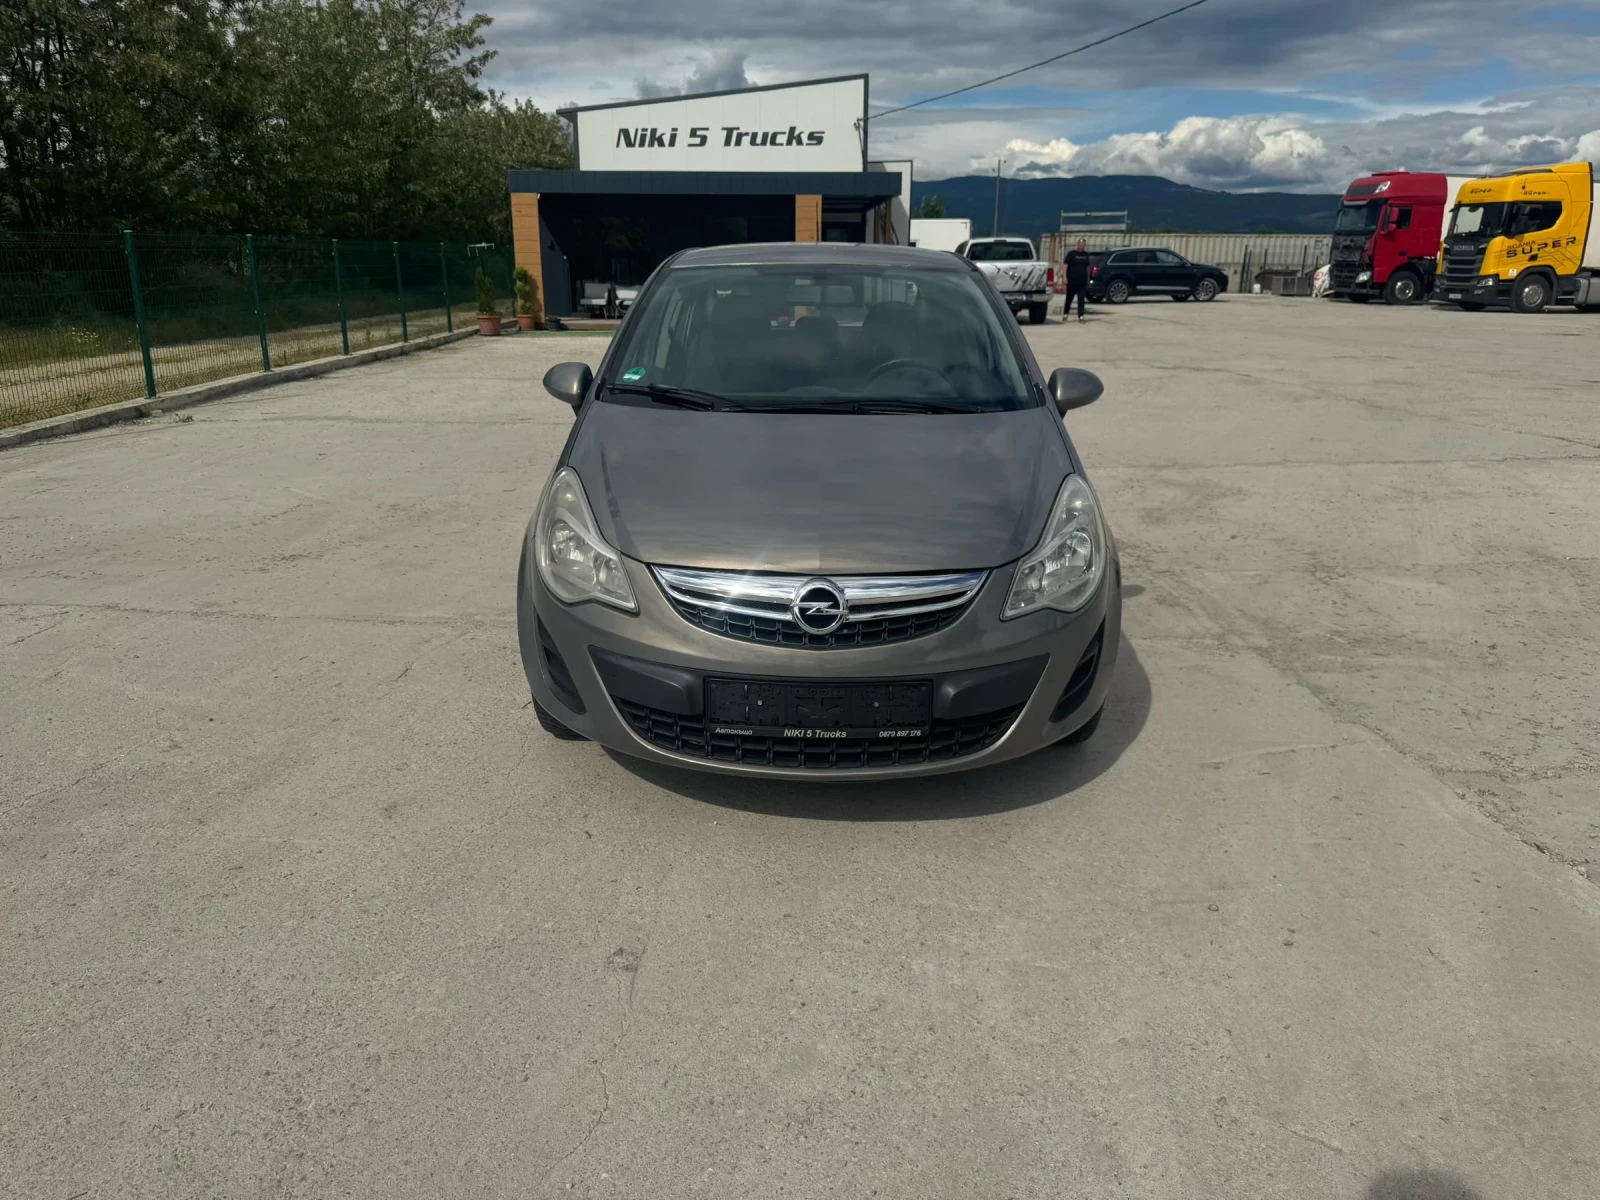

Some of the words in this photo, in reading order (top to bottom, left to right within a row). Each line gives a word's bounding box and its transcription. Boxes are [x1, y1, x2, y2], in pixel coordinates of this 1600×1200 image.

[616, 128, 678, 148] Niki
[688, 127, 710, 147] 5
[721, 126, 826, 147] Trucks
[1506, 236, 1577, 258] SUPER
[1507, 239, 1536, 250] SCANIA
[715, 727, 753, 736] Автокъща
[783, 729, 804, 737] NIKI
[806, 730, 812, 738] 5
[815, 730, 847, 738] Trucks
